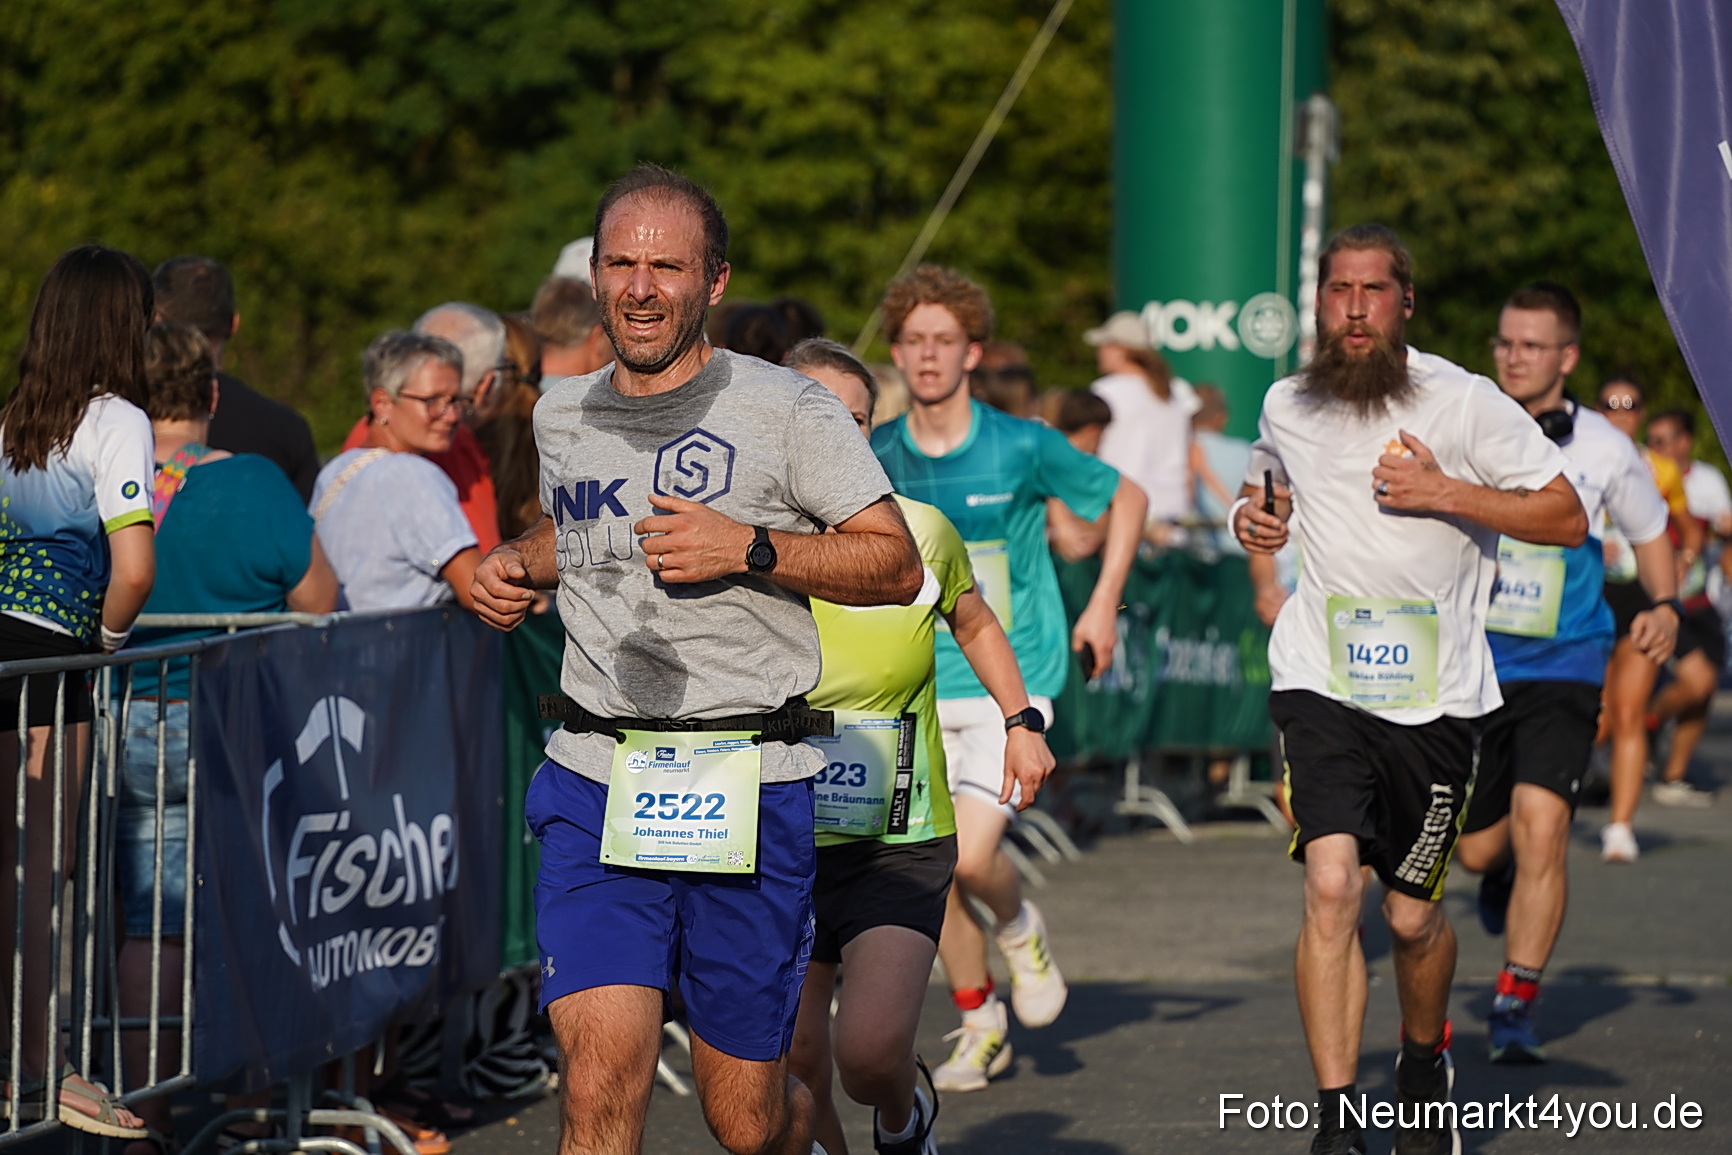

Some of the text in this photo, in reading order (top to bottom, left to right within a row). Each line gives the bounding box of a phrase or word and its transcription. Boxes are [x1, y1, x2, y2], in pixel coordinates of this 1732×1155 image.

[556, 523, 633, 571] SOLU
[1346, 643, 1409, 665] 1420
[648, 760, 692, 769] Firmenlauf
[633, 792, 726, 821] 2522
[831, 792, 885, 805] Bräumann
[632, 826, 729, 840] Johannes Thiel
[286, 793, 460, 926] Fische
[308, 922, 441, 992] UTOMOB
